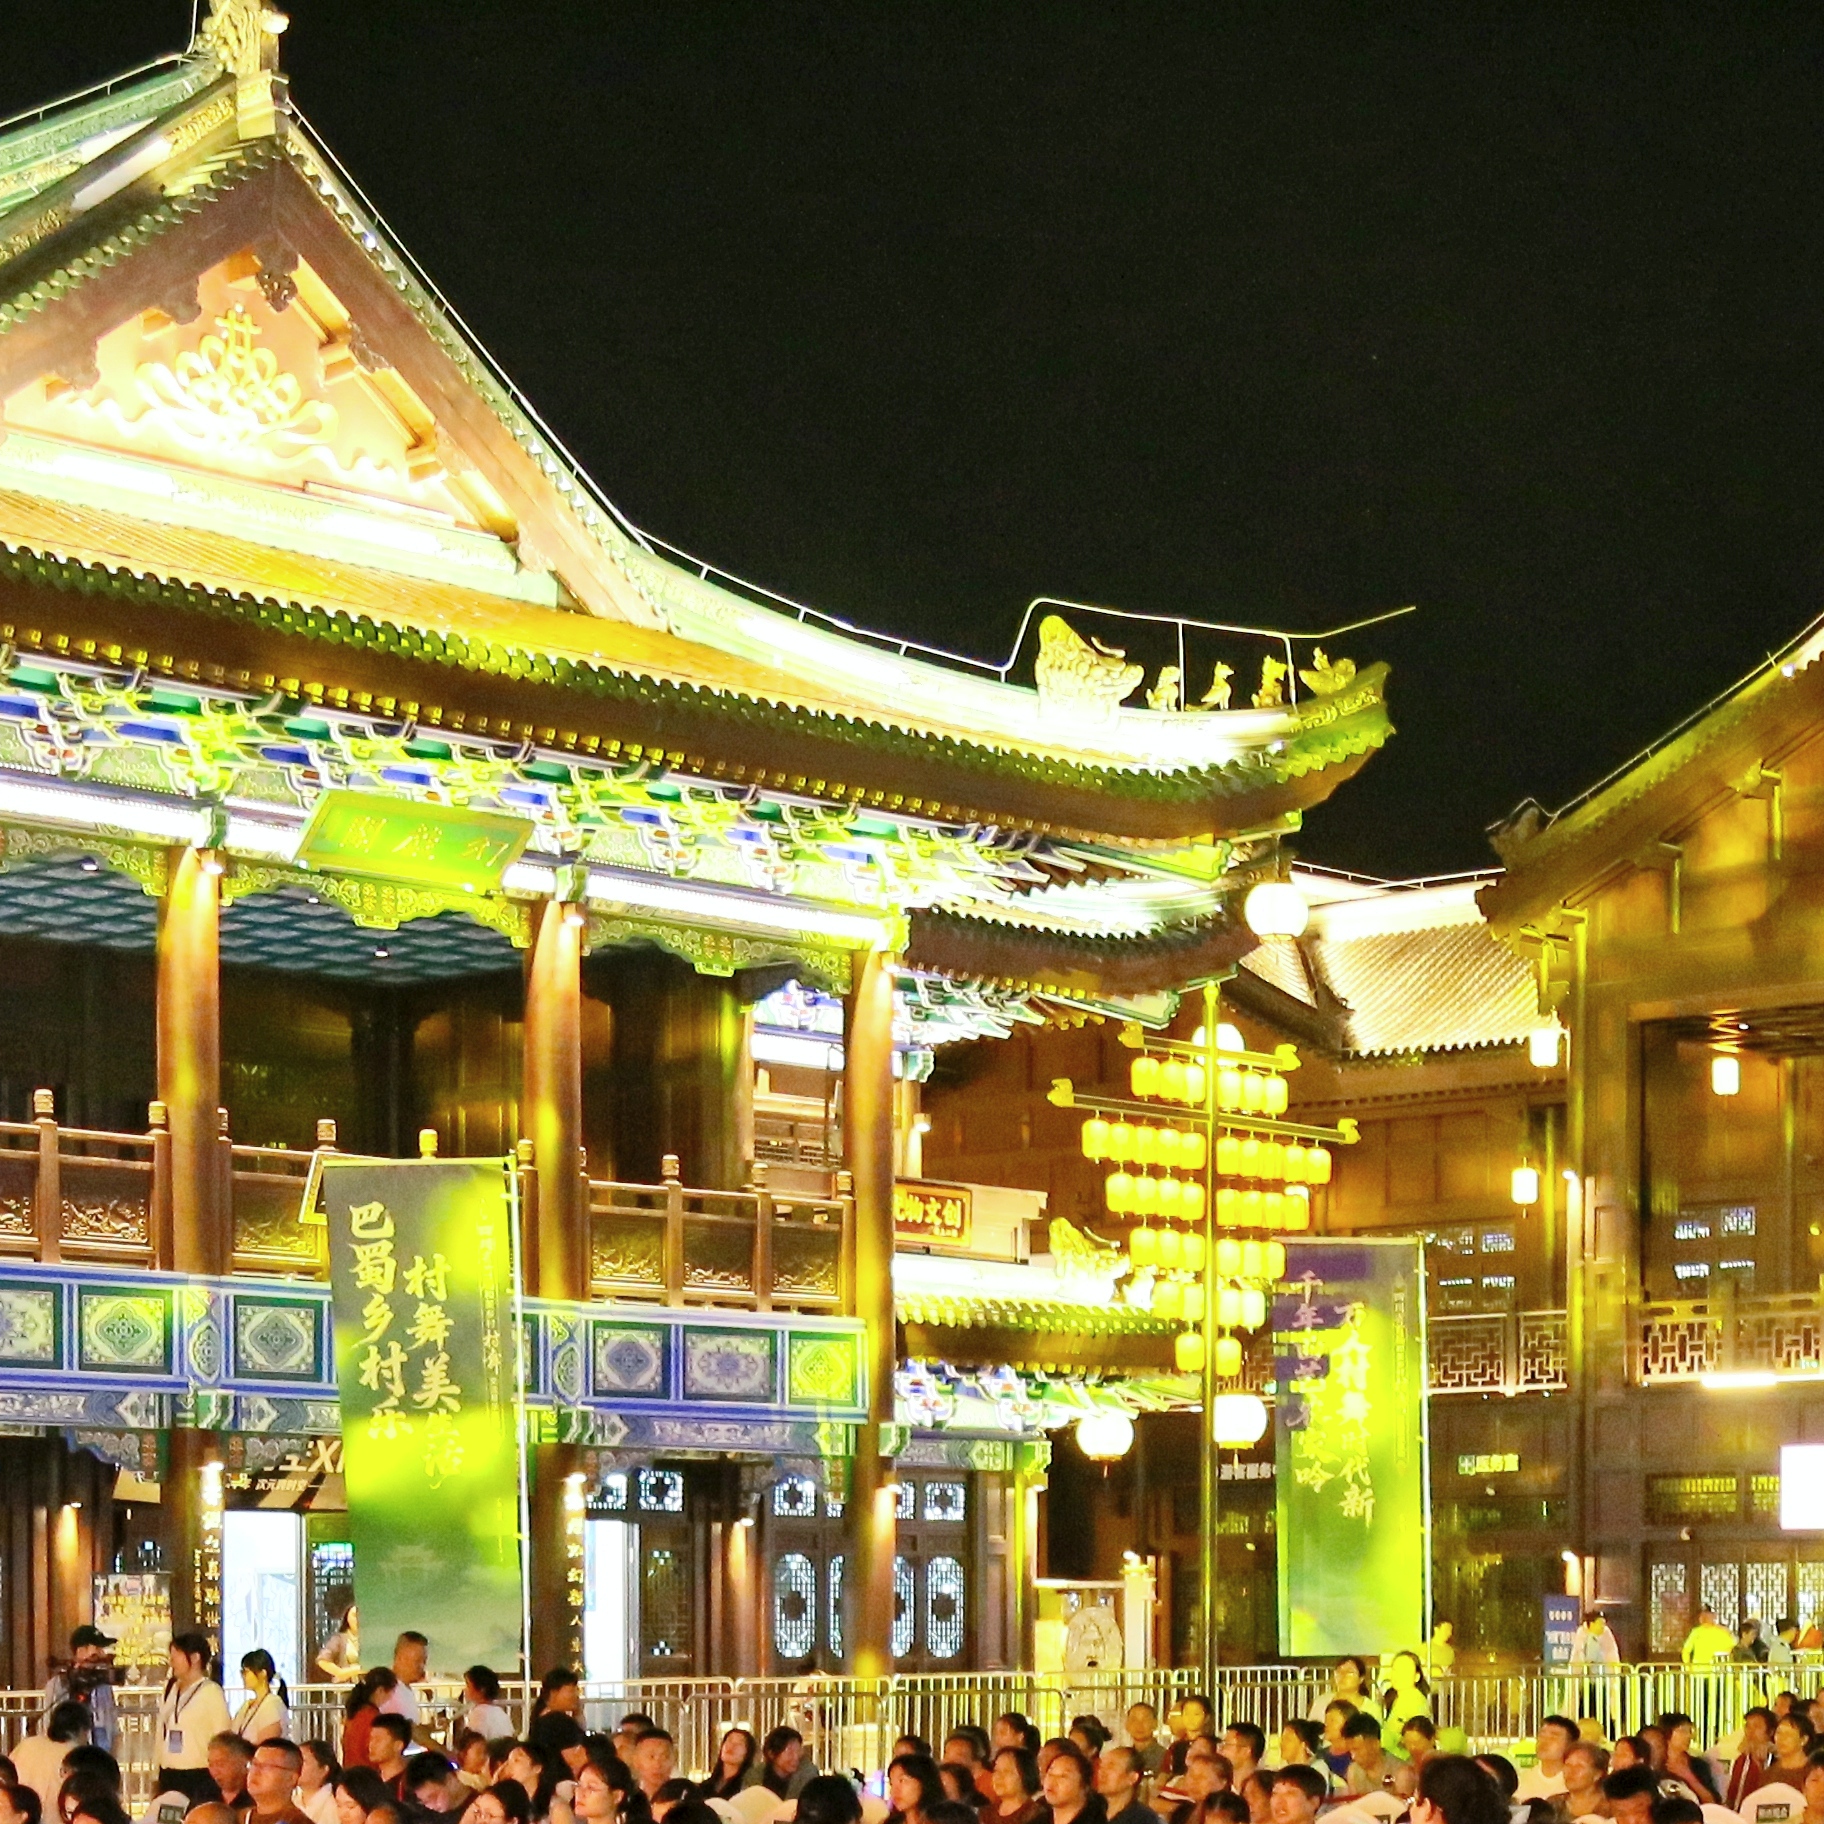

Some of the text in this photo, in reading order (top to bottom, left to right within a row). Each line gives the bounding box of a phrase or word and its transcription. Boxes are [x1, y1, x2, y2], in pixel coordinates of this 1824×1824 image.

[403, 1253, 464, 1489] 村舞美生活
